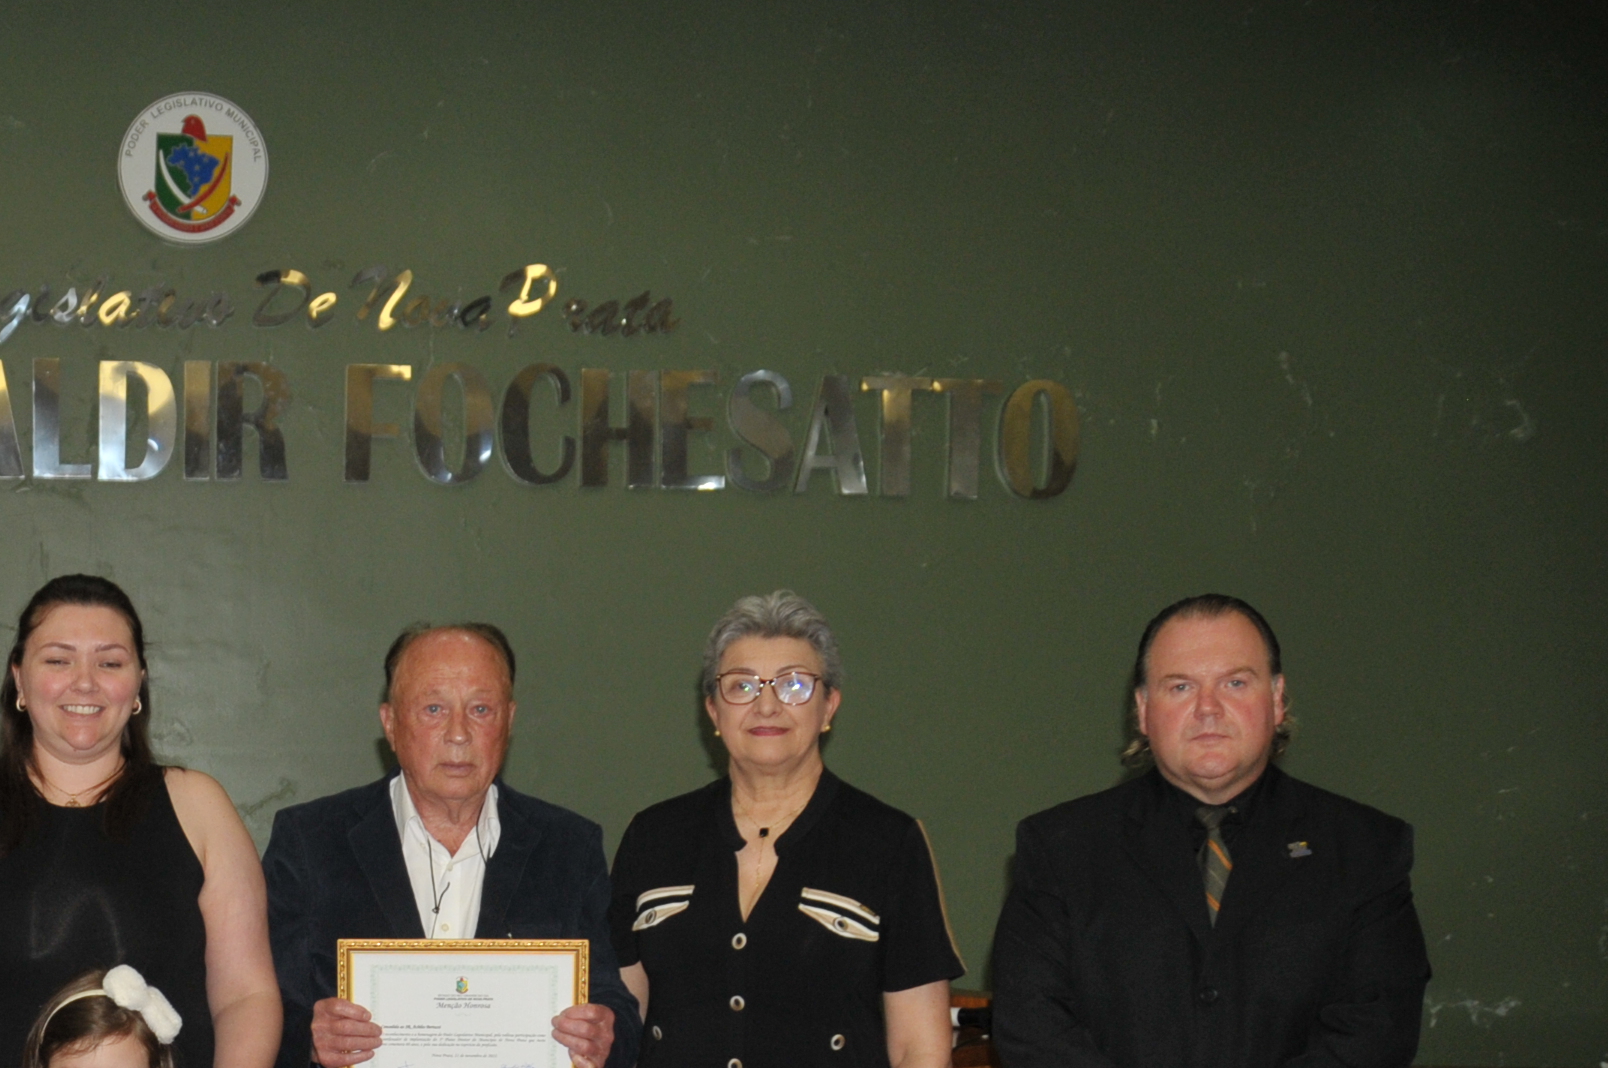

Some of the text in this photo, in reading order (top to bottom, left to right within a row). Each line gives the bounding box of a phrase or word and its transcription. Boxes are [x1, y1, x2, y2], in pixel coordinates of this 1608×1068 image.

[125, 97, 262, 162] PODER LEGISLATIVO MUNICIPAL
[349, 263, 492, 331] Nova
[499, 263, 681, 338] Prata
[341, 362, 1080, 500] FOCHESATTO
